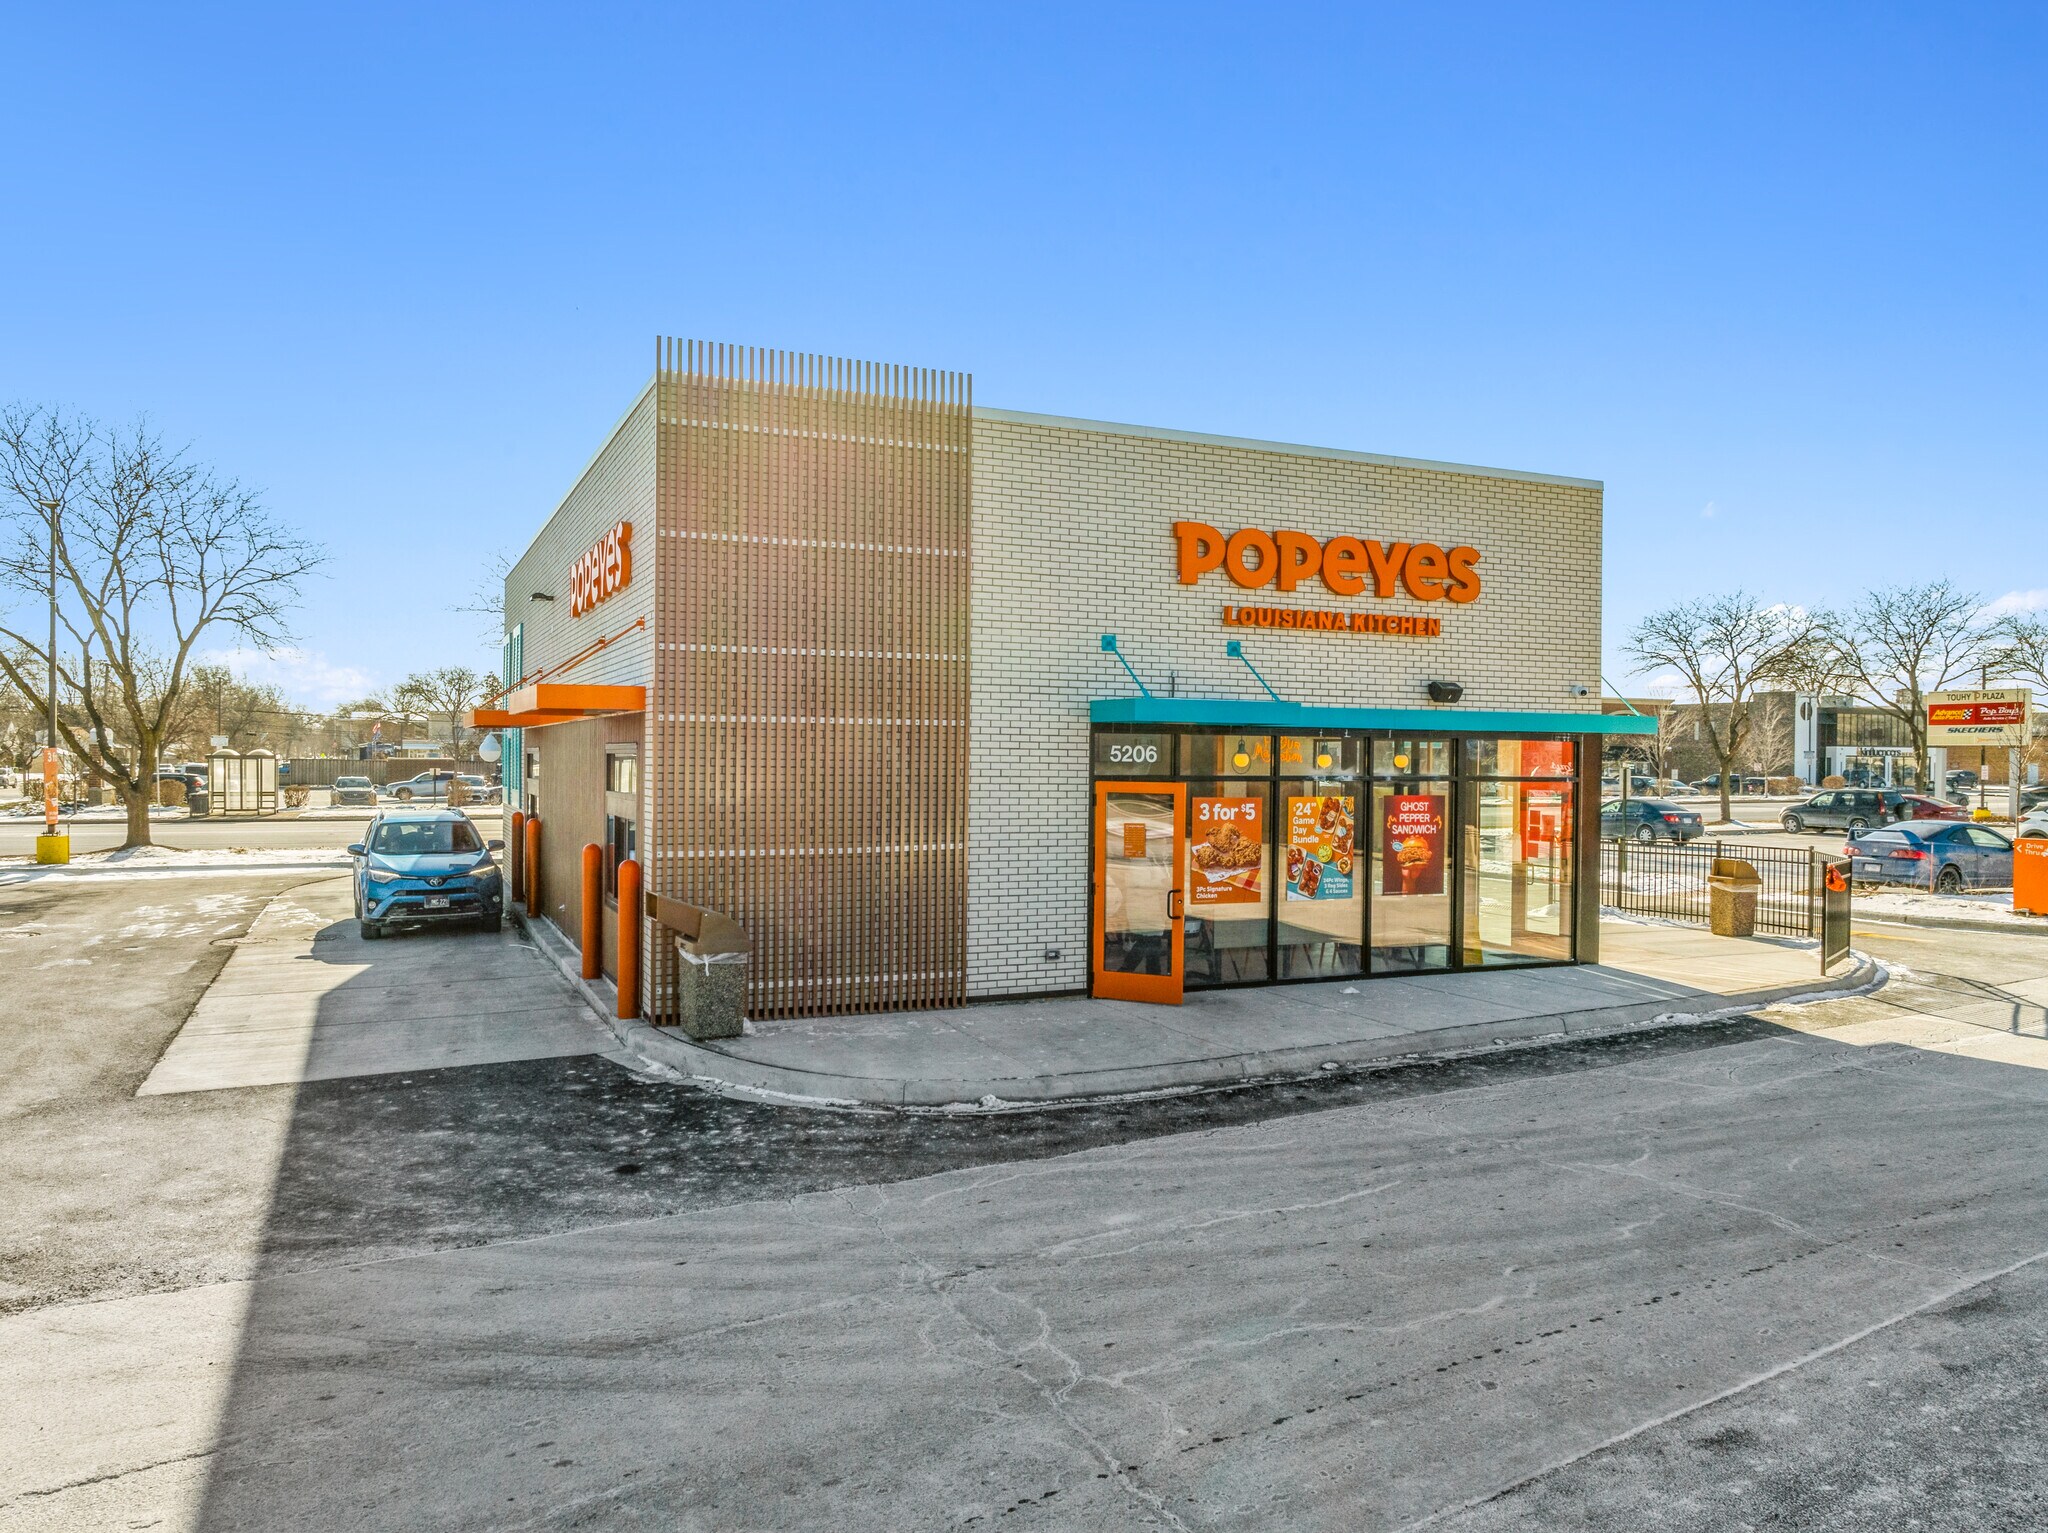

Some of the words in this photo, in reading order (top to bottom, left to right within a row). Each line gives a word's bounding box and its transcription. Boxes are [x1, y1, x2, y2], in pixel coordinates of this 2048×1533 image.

[1222, 606, 1347, 632] LOUISIANA
[1347, 614, 1441, 637] KITCHEN
[1982, 692, 2005, 700] PLAZA
[1109, 744, 1158, 763] 5206
[1199, 803, 1210, 821] 3
[1212, 803, 1239, 821] for
[1240, 803, 1256, 821] $5
[1400, 802, 1429, 812] GHOST
[1292, 816, 1315, 825] Game
[1399, 813, 1430, 823] PEPPER
[1292, 826, 1308, 836] Day
[1391, 824, 1437, 835] SANDWICH
[1292, 835, 1319, 844] Bundle
[2025, 842, 2044, 850] Drive
